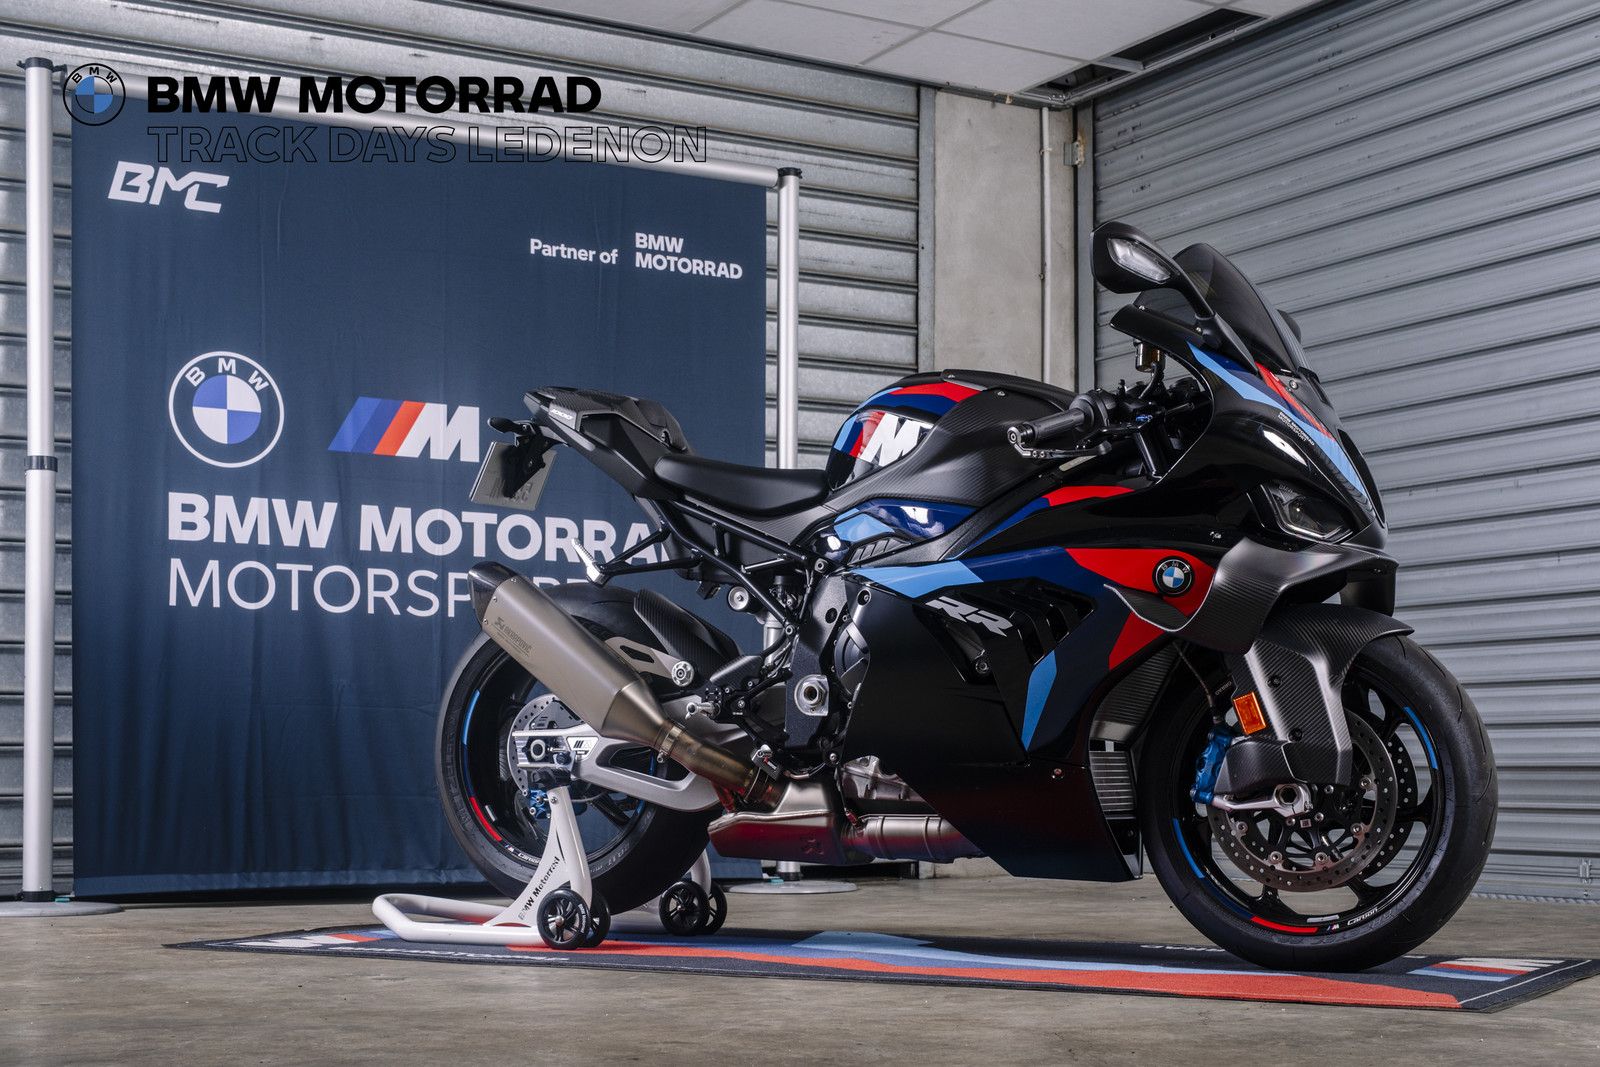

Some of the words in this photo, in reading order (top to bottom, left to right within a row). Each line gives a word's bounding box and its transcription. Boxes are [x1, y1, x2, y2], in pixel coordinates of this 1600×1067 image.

[108, 161, 230, 213] BMC
[530, 238, 596, 262] Partner
[599, 249, 619, 264] of
[635, 232, 684, 253] BMW
[635, 251, 743, 279] MOTORRAD
[168, 491, 338, 549] BMW
[359, 504, 670, 566] MOTORRA
[169, 558, 590, 618] MOTORSP
[925, 595, 1014, 637] RR
[532, 856, 561, 898] Motorrad
[1347, 906, 1379, 926] Carbon
